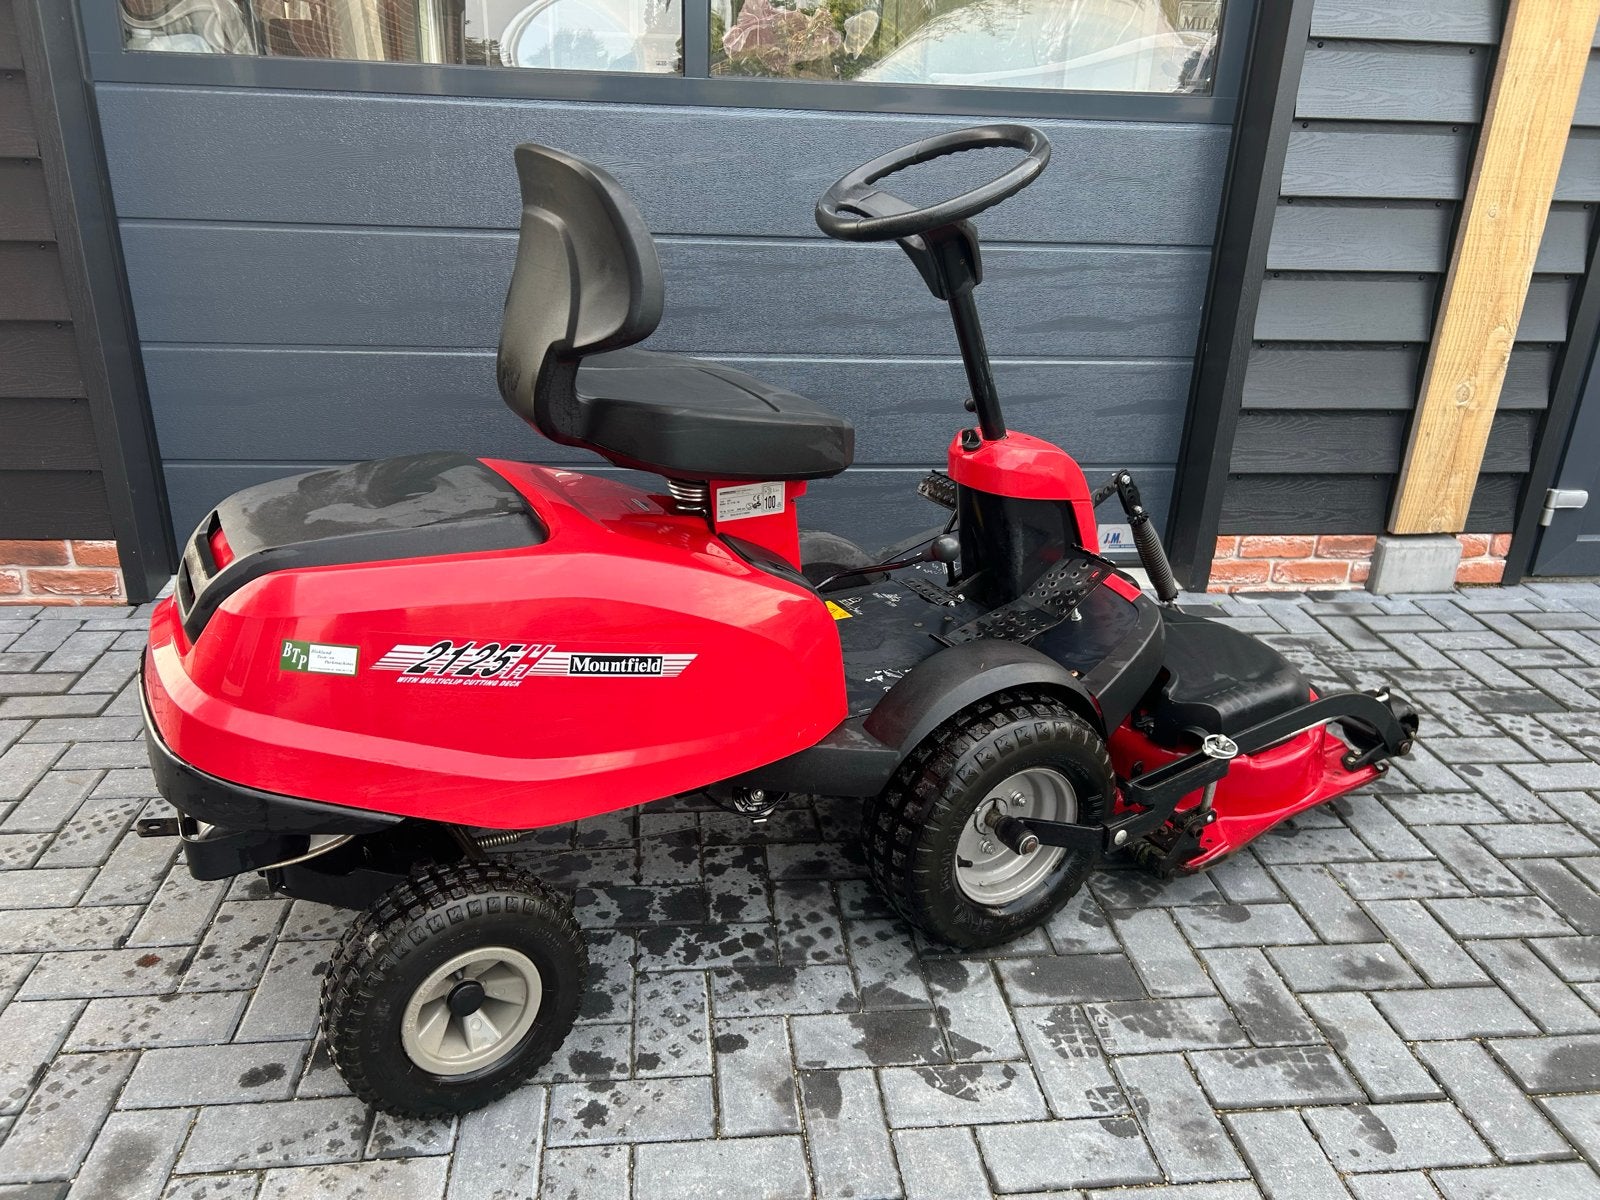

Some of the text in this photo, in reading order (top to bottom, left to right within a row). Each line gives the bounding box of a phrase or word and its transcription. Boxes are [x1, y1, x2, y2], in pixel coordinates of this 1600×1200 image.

[764, 495, 776, 510] 100
[1103, 533, 1122, 544] J.M.
[571, 656, 661, 673] Mountfield
[396, 676, 522, 688] WITH MULTICLIP CUTTING DECK
